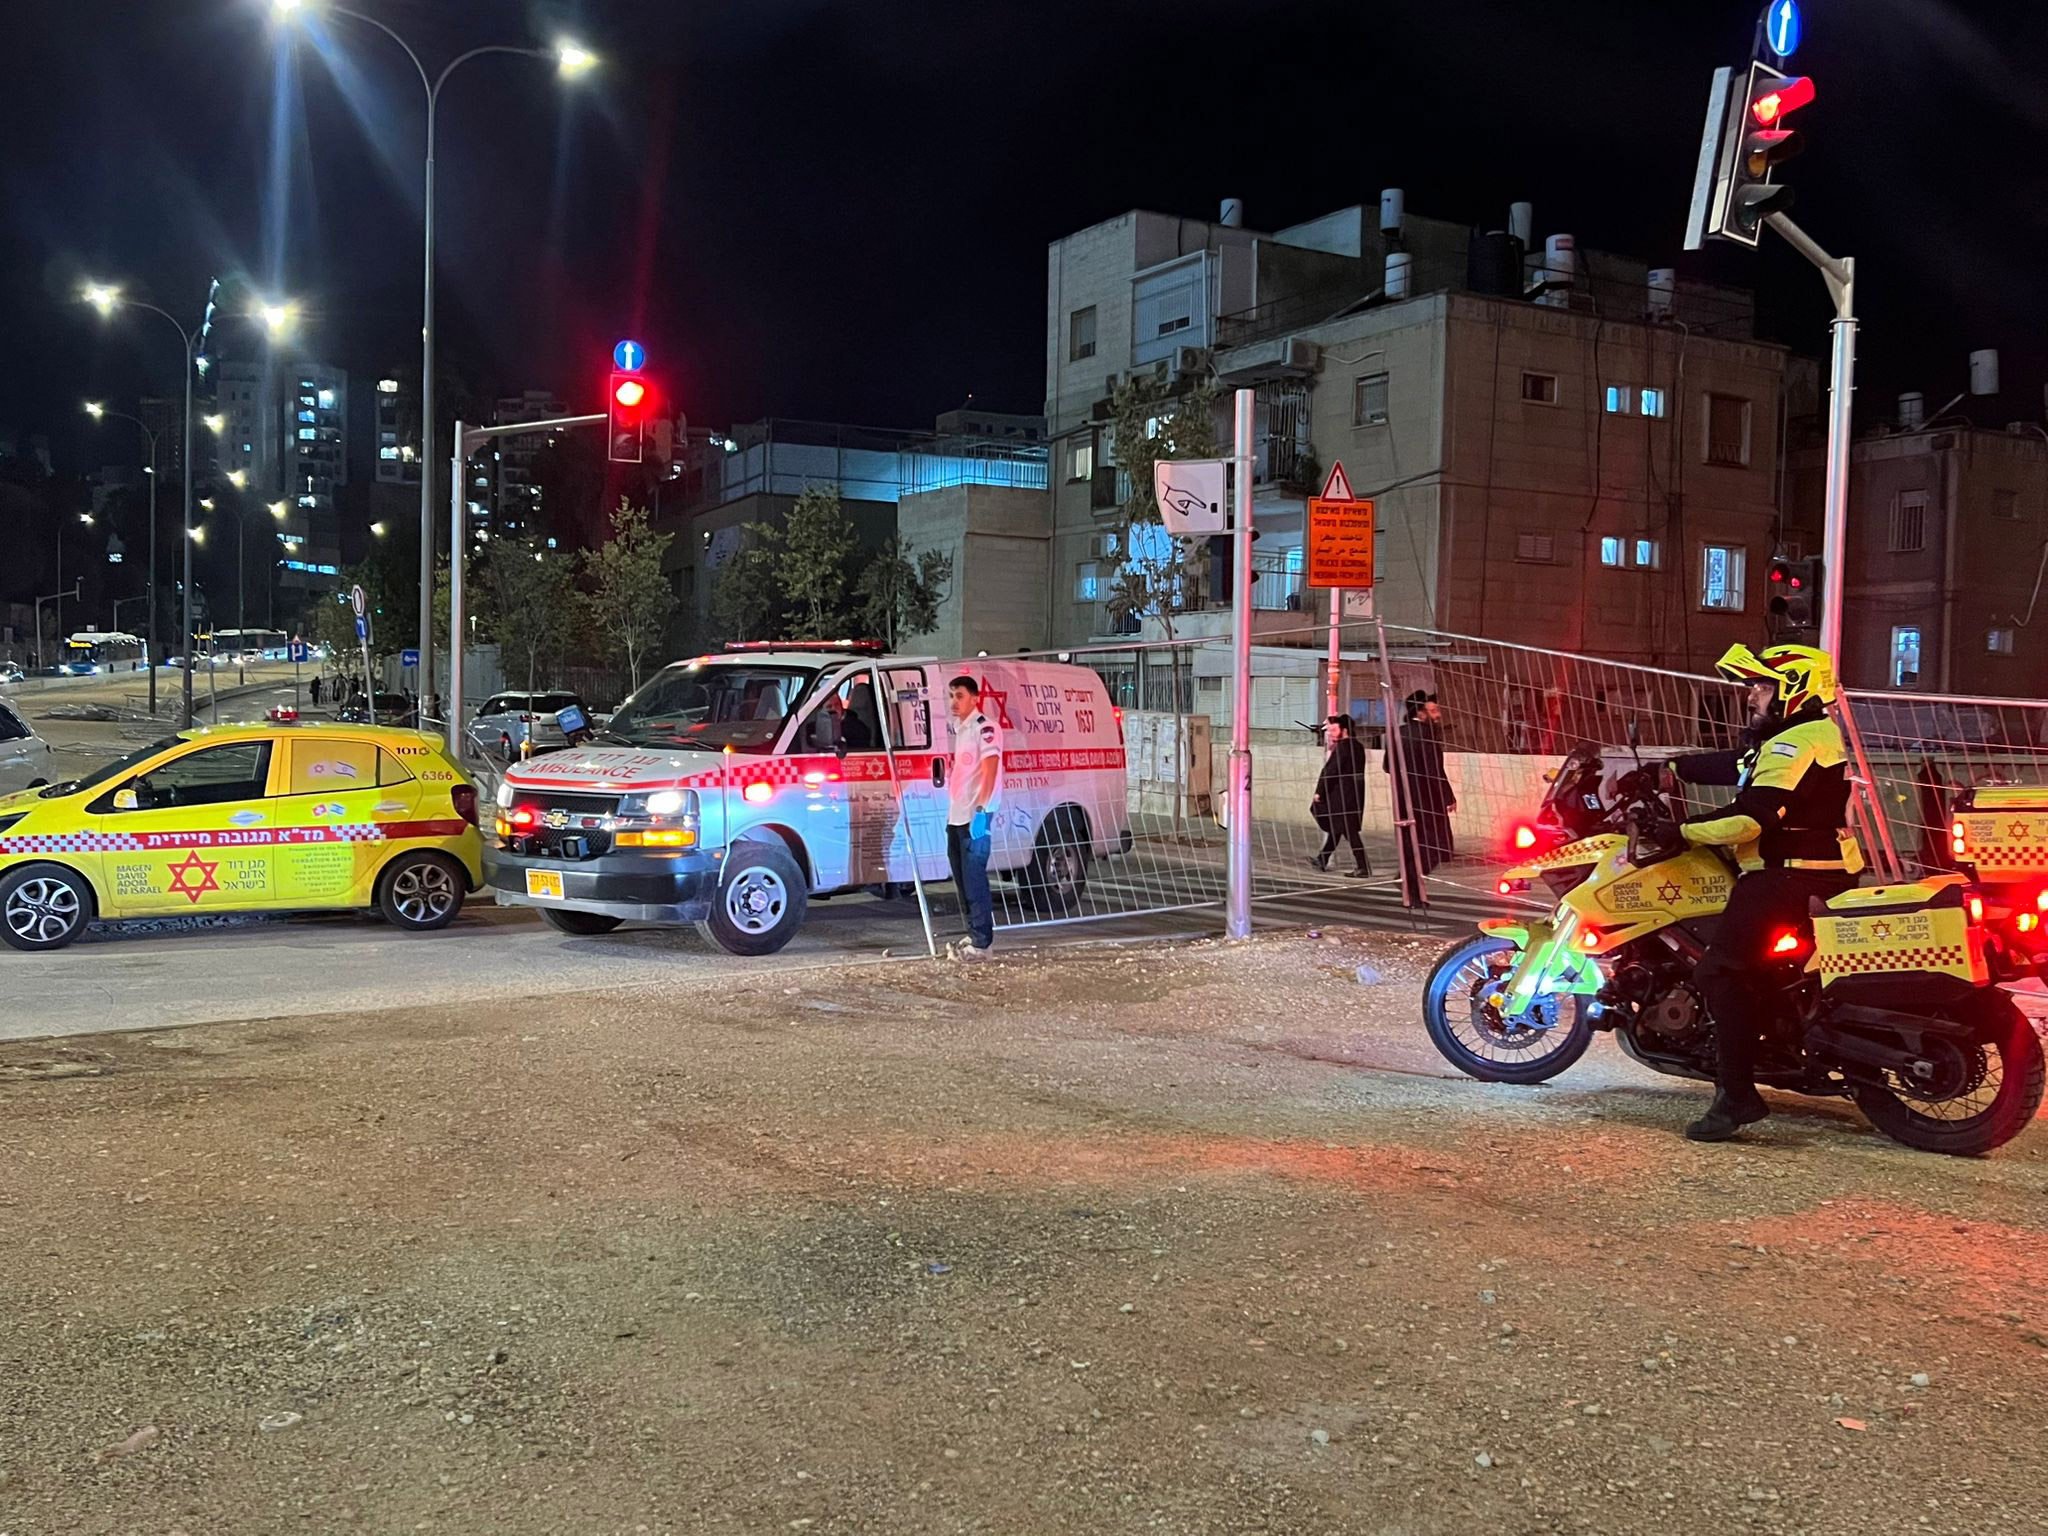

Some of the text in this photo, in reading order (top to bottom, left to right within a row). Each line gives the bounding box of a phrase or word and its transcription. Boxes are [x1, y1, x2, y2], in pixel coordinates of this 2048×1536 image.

[1020, 684, 1058, 701] מגן דוד
[1036, 701, 1062, 716] אדום
[1024, 716, 1064, 734] בישראל
[1006, 754, 1037, 769] AMERICAN
[1038, 753, 1060, 768] FRIENDS
[1061, 752, 1069, 767] OF
[1069, 752, 1090, 767] MAGEN
[421, 771, 453, 781] 6366
[522, 763, 643, 780] AMBULANCE
[148, 833, 211, 846] מיידית
[219, 831, 271, 844] תגובה
[116, 864, 152, 872] MAGEN
[225, 859, 266, 870] מגן דוד
[116, 871, 147, 880] DAVID
[239, 869, 266, 879] אדום
[117, 879, 148, 887] ADOM
[223, 879, 266, 890] בישראל
[1690, 875, 1725, 885] מגן דוד
[130, 885, 162, 895] ISRAEL
[1613, 882, 1643, 890] MAGEN
[1701, 885, 1727, 895] אדום
[1613, 889, 1640, 897] DAVID
[1614, 895, 1640, 903] ADOM
[1688, 895, 1727, 905] בישראל
[1626, 900, 1654, 909] ISRAEL
[1914, 916, 1928, 924] מגן
[1907, 924, 1929, 932] אדום
[1846, 936, 1868, 945] ISRAEL
[1896, 932, 1930, 941] בישראל
